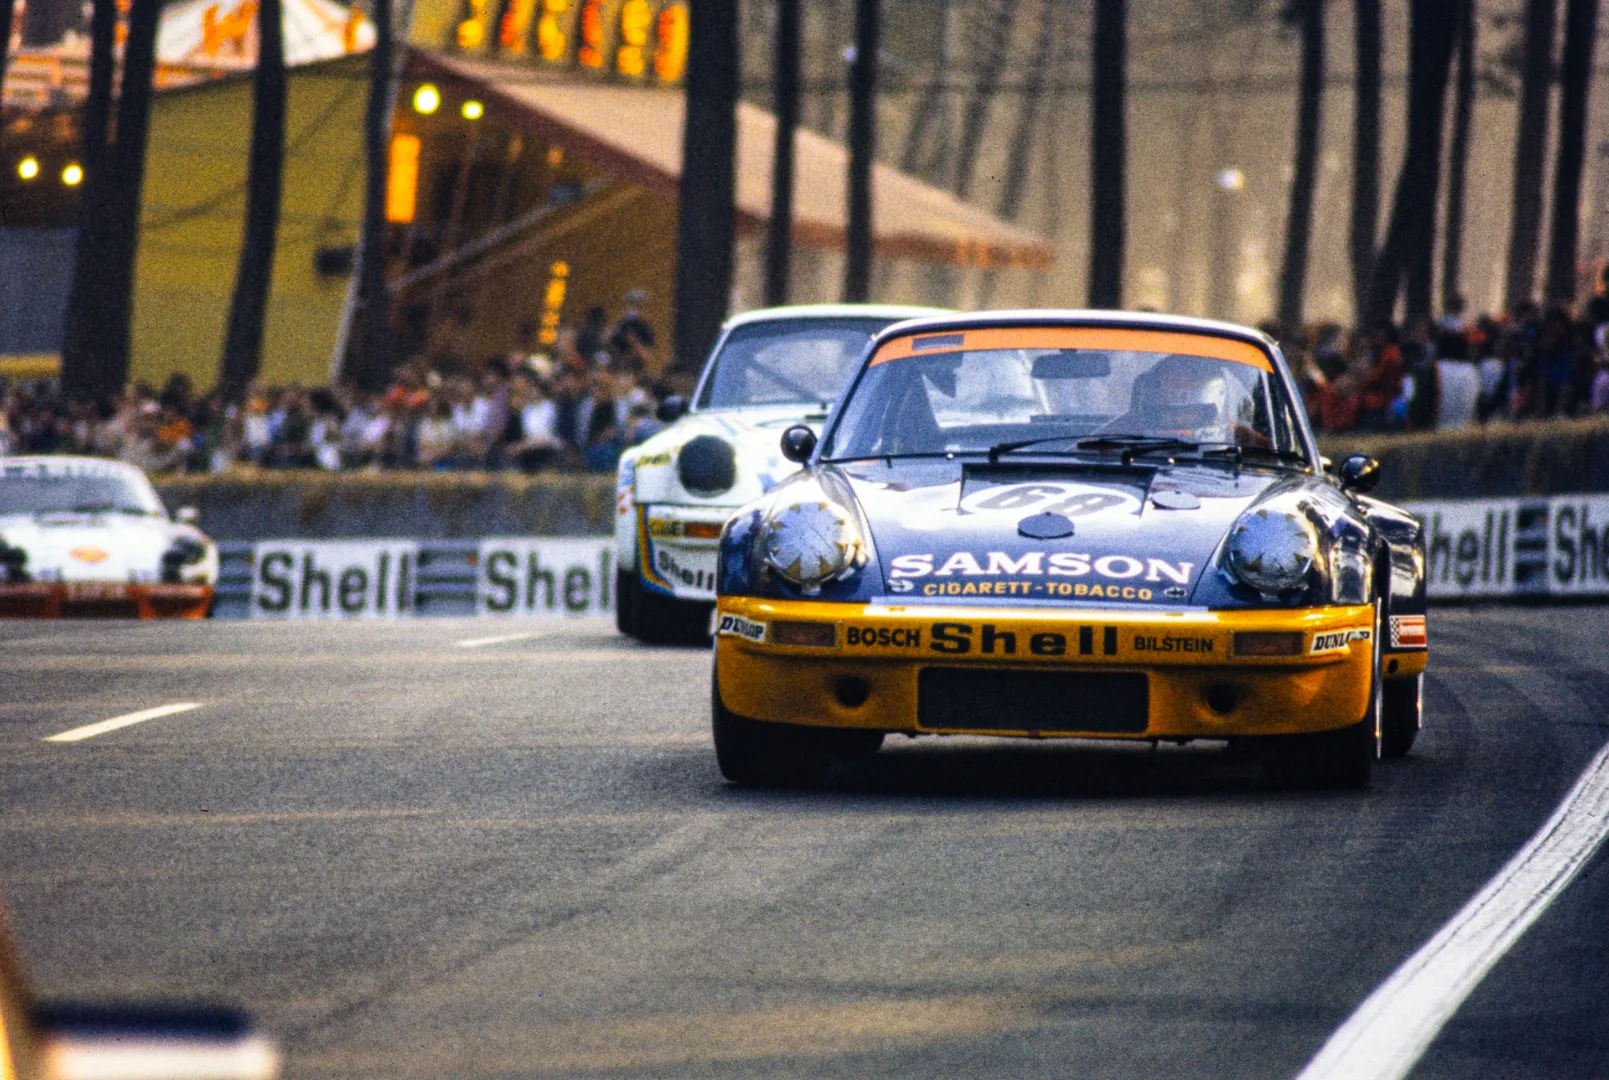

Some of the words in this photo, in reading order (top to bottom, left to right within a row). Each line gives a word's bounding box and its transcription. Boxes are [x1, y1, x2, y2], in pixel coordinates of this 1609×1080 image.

[1415, 509, 1509, 585] hell
[259, 551, 410, 612] Shell
[486, 550, 611, 612] Shel
[659, 550, 714, 591] Shell
[891, 551, 1194, 584] SAMSON
[847, 627, 920, 648] BOSCH
[930, 622, 1118, 656] Shell
[1133, 636, 1213, 652] BILSTEIN
